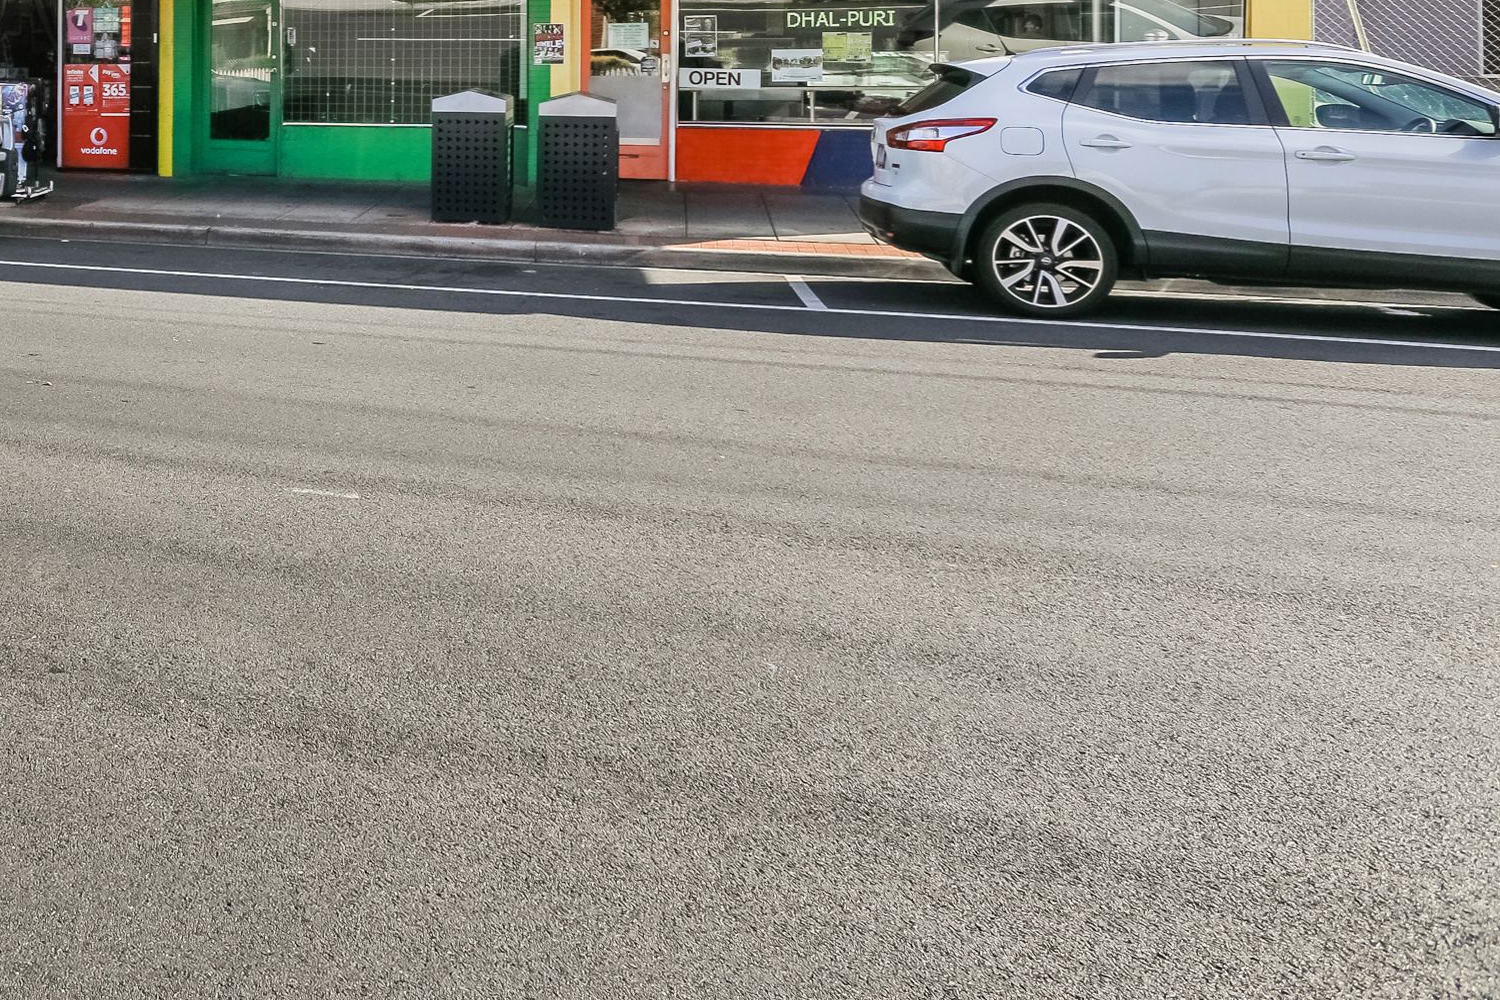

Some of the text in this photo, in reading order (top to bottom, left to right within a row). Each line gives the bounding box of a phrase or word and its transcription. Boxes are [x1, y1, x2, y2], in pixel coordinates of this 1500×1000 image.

[75, 10, 89, 26] T
[787, 11, 896, 28] DHAL-PURI
[689, 71, 741, 86] OPEN
[102, 83, 127, 97] 365
[80, 147, 117, 155] vodafone
